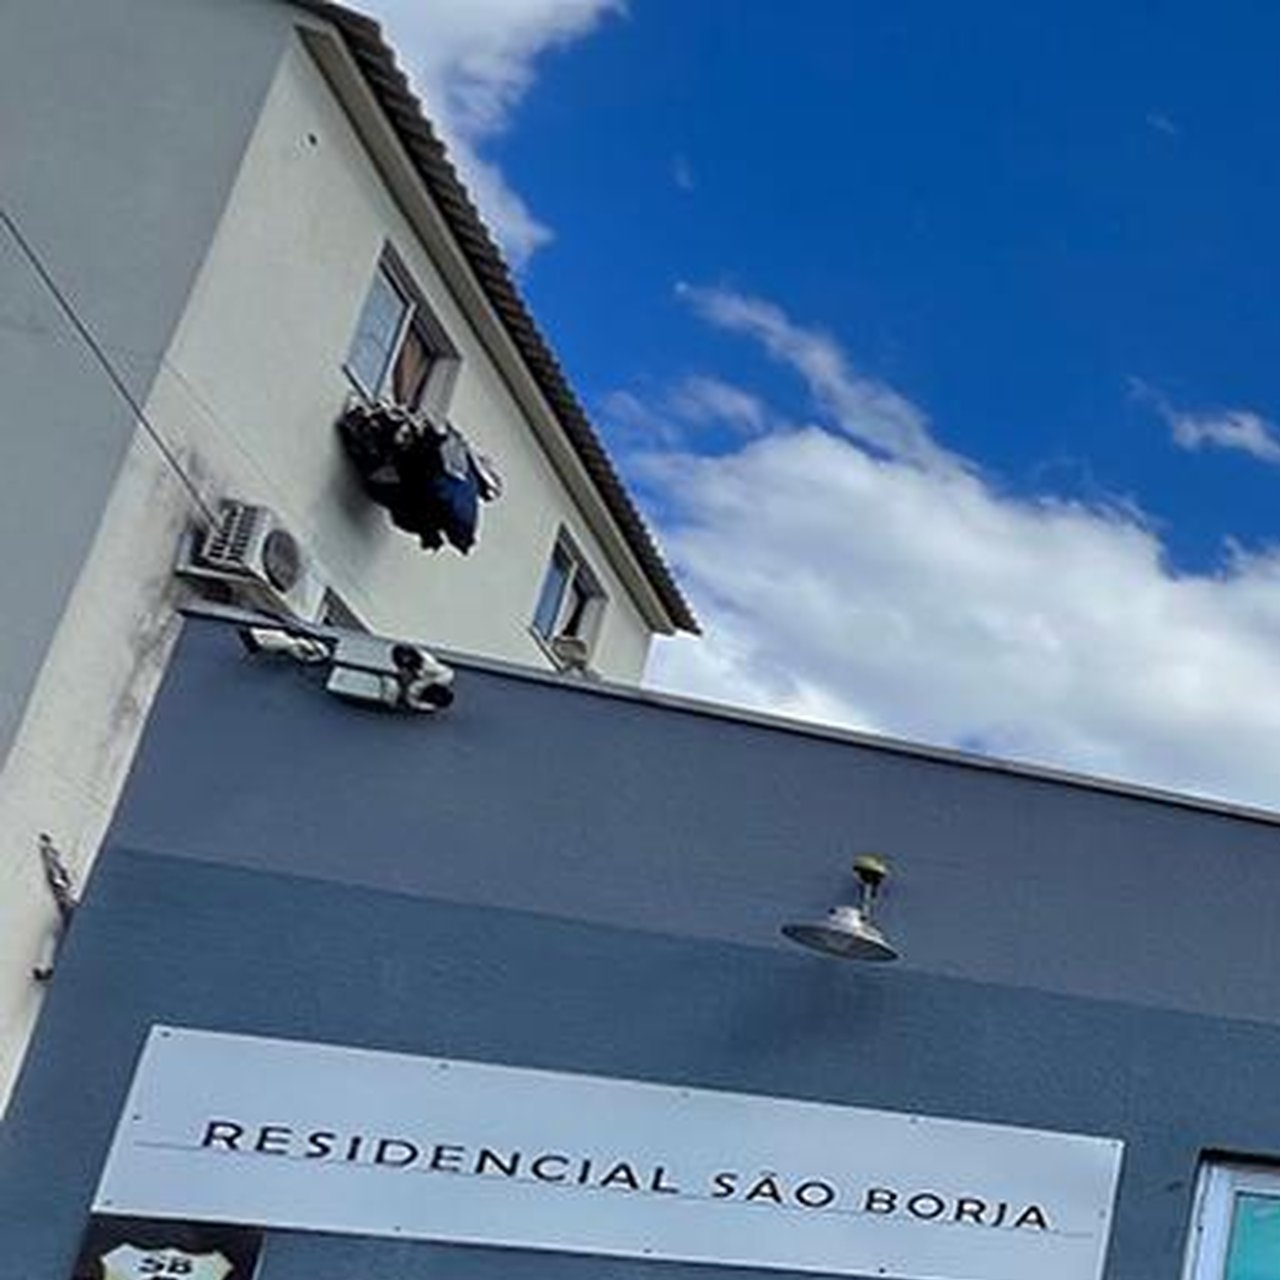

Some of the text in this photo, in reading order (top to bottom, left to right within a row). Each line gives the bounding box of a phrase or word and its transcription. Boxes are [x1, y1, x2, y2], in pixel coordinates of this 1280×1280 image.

[201, 1120, 1048, 1230] RESIDENCIAL SÃO BORJA
